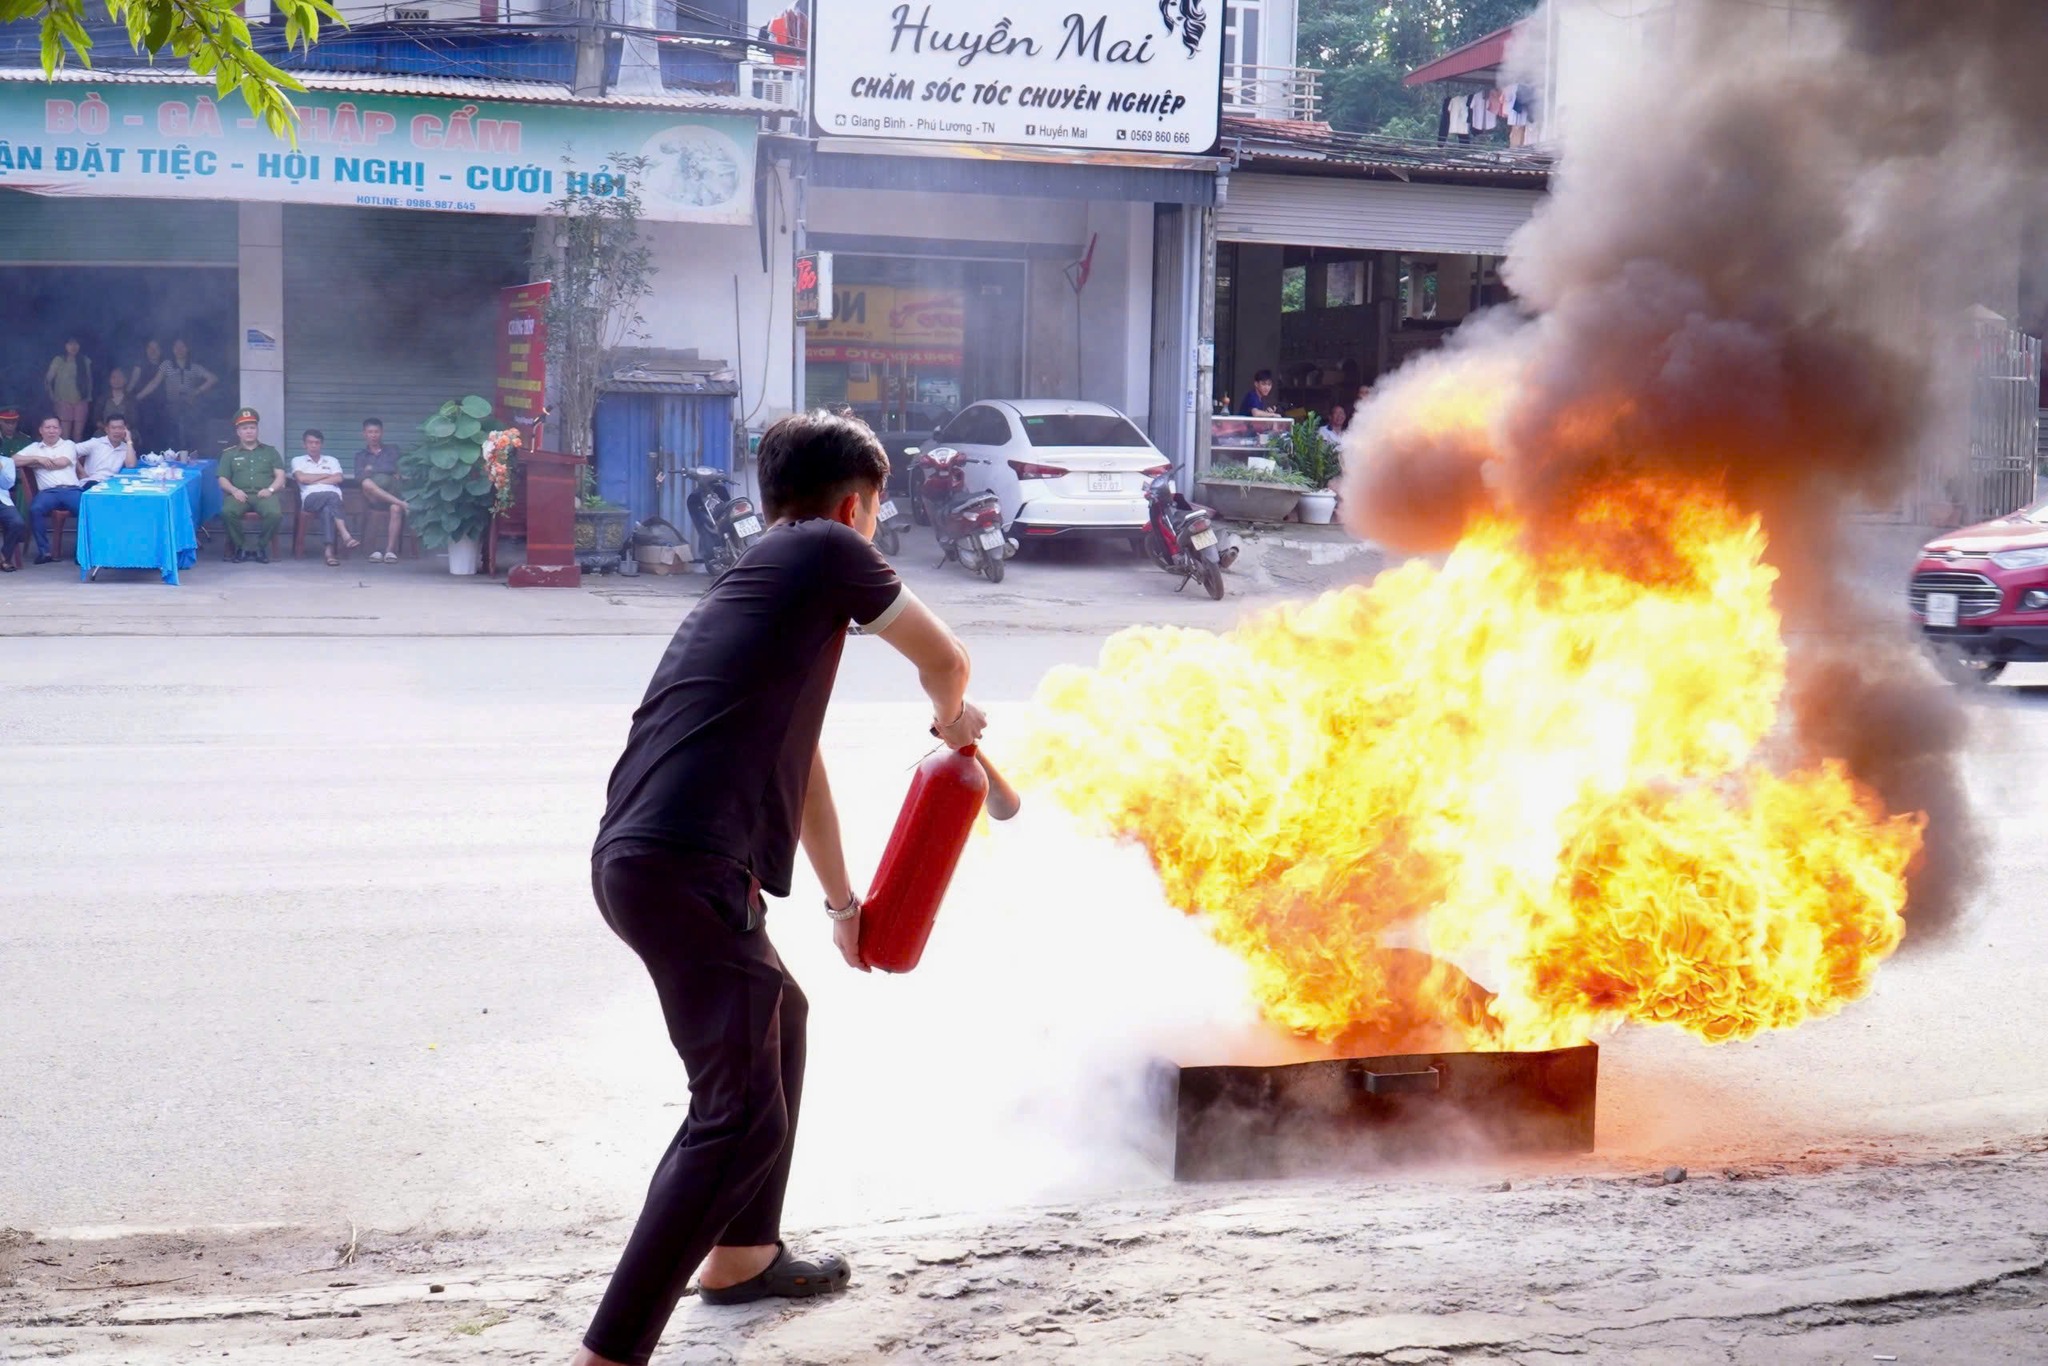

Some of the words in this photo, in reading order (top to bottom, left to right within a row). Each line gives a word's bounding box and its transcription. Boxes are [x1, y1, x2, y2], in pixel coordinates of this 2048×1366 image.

[888, 3, 1041, 67] Huyền
[1055, 12, 1155, 65] Mai
[850, 73, 914, 101] CHĂM
[921, 76, 965, 104] SÓC
[973, 80, 1011, 107] TÓC
[1018, 83, 1102, 112] CHUYÊN
[1107, 90, 1186, 122] NGHIỆP
[46, 92, 110, 135] BÒ
[158, 96, 224, 138] GÀ
[410, 104, 523, 154] CẨM
[851, 115, 880, 130] Giang
[884, 117, 906, 129] Bình
[917, 119, 937, 131] Phú
[939, 120, 972, 135] Lương
[982, 122, 996, 134] TN
[1071, 126, 1088, 139] Mai
[1131, 130, 1153, 142] 0569
[1155, 131, 1171, 143] 860
[1173, 132, 1190, 144] 666
[55, 142, 125, 178] ĐẶT
[137, 144, 217, 180] TIỆC
[258, 149, 320, 184] HỘI
[335, 156, 424, 192] NGHỊ
[466, 163, 553, 195] CƯỚI
[356, 195, 403, 207] HOTLINE:
